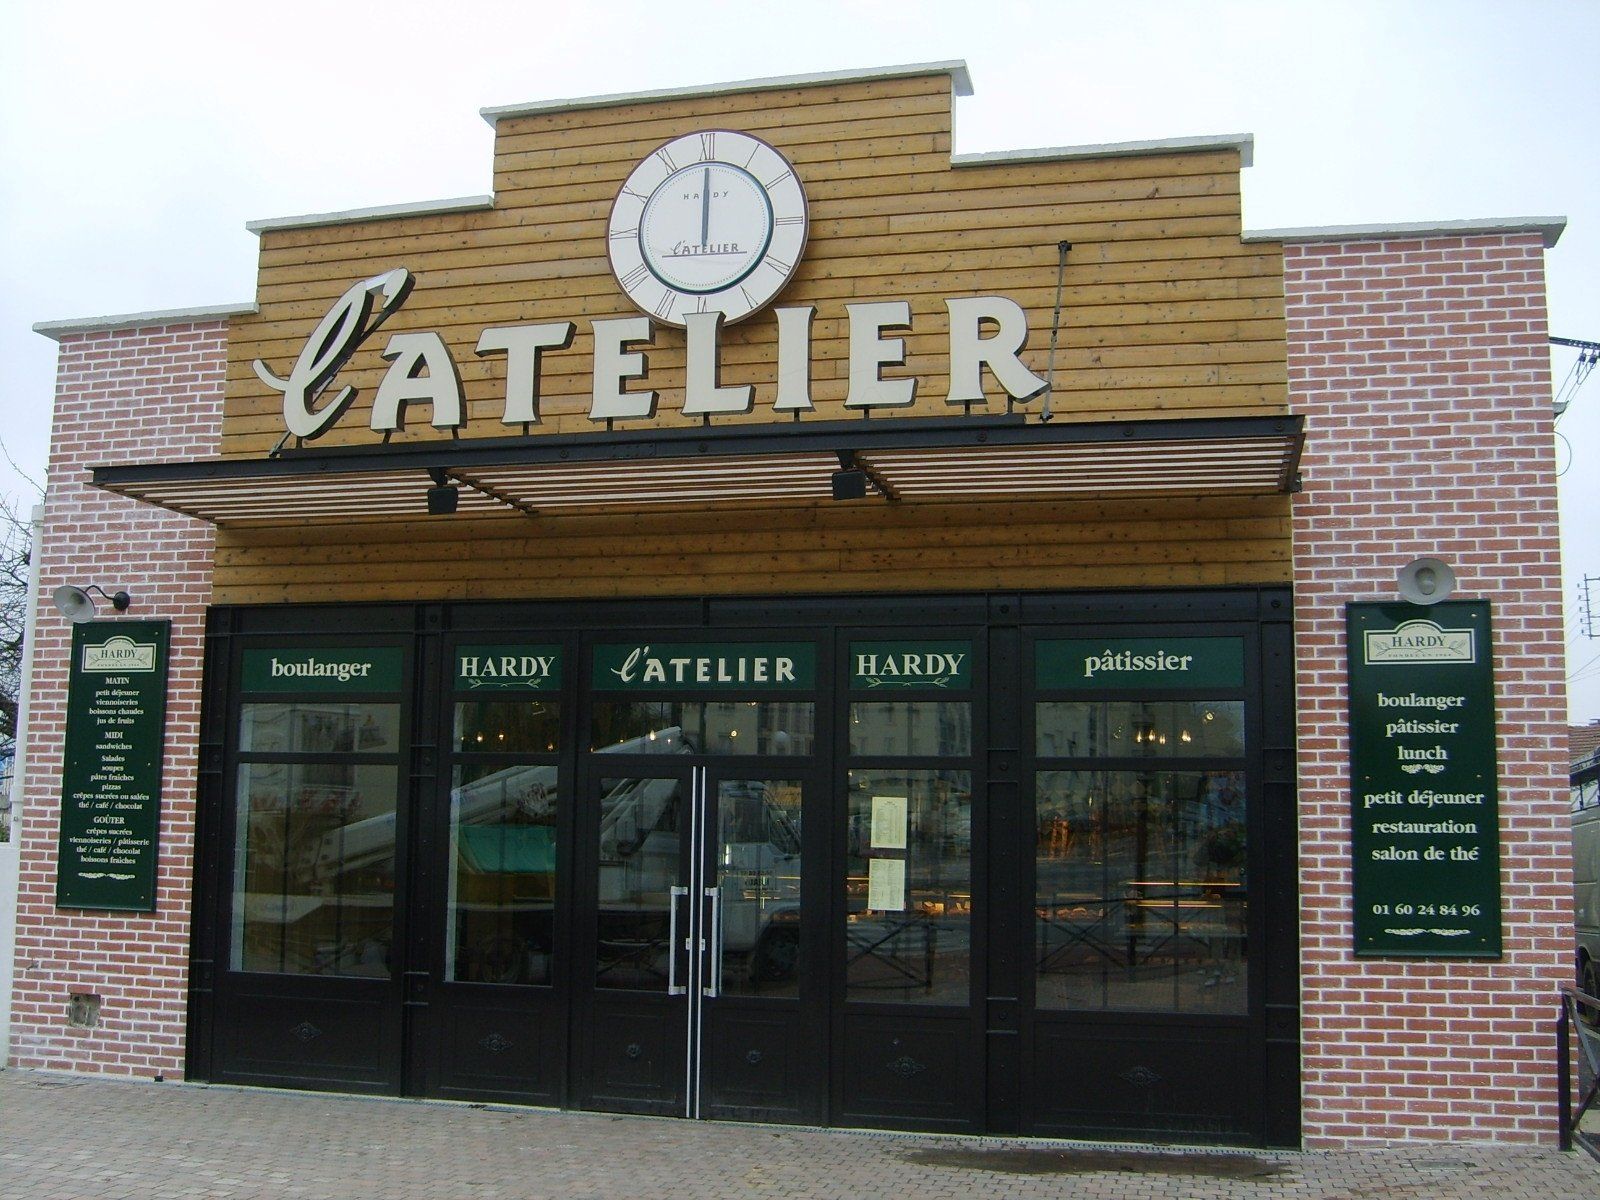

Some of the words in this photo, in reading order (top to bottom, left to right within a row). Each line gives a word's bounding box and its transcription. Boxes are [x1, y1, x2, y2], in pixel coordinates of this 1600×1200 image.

[684, 191, 728, 199] HADY
[670, 240, 738, 255] l'ATELIER
[252, 267, 1049, 438] l'ATELIER
[1392, 636, 1447, 647] HARDY
[101, 650, 138, 658] HARDY
[272, 658, 371, 681] boulanger
[460, 656, 555, 676] HARDY
[611, 645, 795, 682] l'ATELIER
[856, 654, 965, 676] HARDY
[1084, 649, 1192, 677] pâtissier
[95, 689, 110, 697] petit
[111, 689, 139, 697] déjeuner
[1377, 693, 1465, 710] boulanger
[1385, 719, 1459, 737] pâtissier
[1398, 746, 1448, 759] lunch
[91, 773, 107, 781] pâtes
[73, 792, 93, 800] crêpes
[1364, 790, 1403, 808] petit
[1408, 790, 1484, 807] déjeuner
[95, 801, 109, 809] café
[94, 814, 124, 824] GOÛTER
[86, 828, 107, 836] crêpes
[1372, 820, 1477, 833] restauration
[118, 838, 150, 846] pâtisserie
[81, 855, 108, 863] boissons
[1372, 846, 1419, 860] salon
[1424, 846, 1444, 860] de
[1450, 846, 1480, 860] thé
[1373, 904, 1389, 915] 01
[1395, 904, 1412, 915] 60
[1418, 904, 1435, 915] 24
[1439, 904, 1457, 915] 84
[1461, 904, 1480, 917] 96
